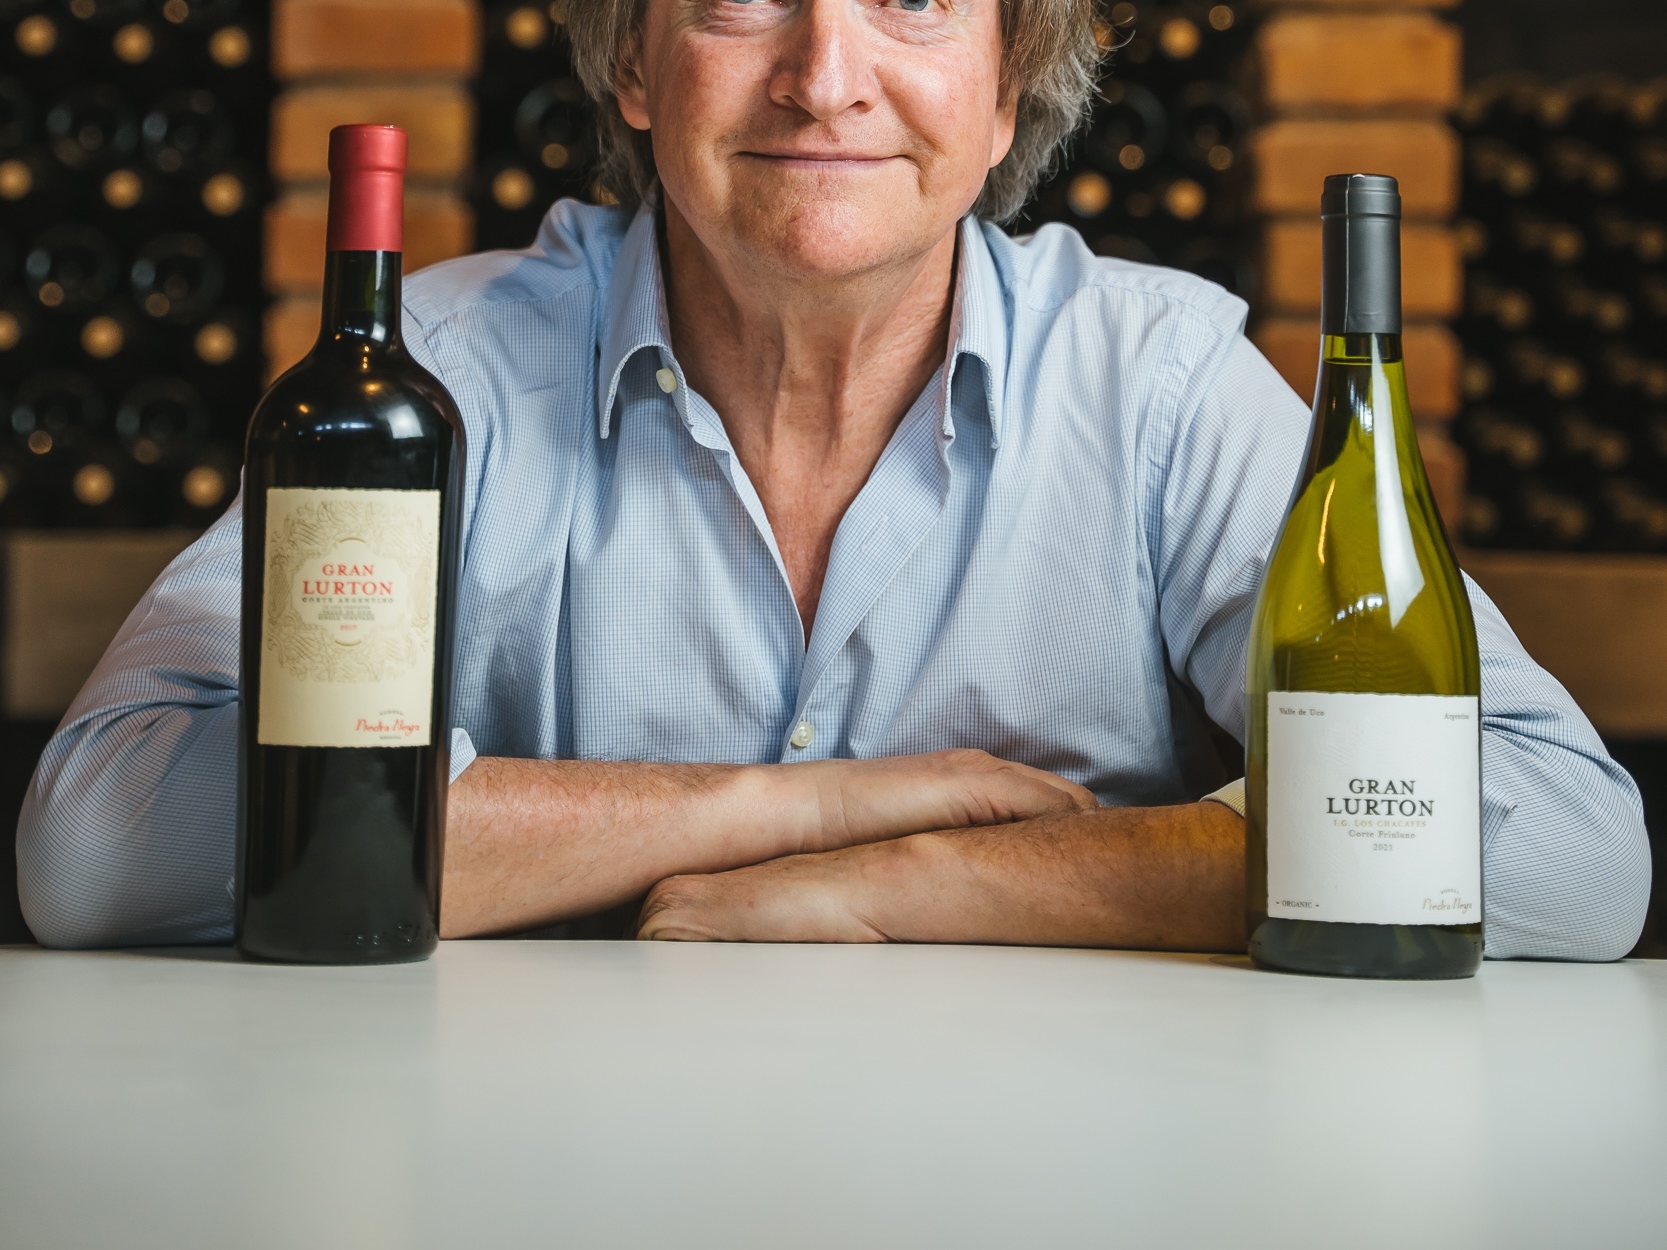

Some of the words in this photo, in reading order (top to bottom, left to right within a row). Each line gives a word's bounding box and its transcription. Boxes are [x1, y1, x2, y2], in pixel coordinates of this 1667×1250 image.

[322, 563, 375, 576] GRAN
[303, 580, 393, 596] LURTON
[1279, 707, 1296, 716] Valle
[1298, 708, 1307, 716] de
[1309, 708, 1325, 717] Uco
[1349, 778, 1416, 795] GRAN
[1326, 797, 1435, 817] LURTON
[1333, 819, 1351, 827] I.G.
[1355, 820, 1373, 828] LOS
[1376, 820, 1427, 828] CHACAYES
[1348, 829, 1374, 838] Corte
[1378, 830, 1416, 839] Friulano
[1373, 843, 1394, 852] 2021
[1281, 900, 1312, 909] ORGANIC
[1422, 898, 1451, 911] Piedra
[1452, 897, 1473, 915] Negra
